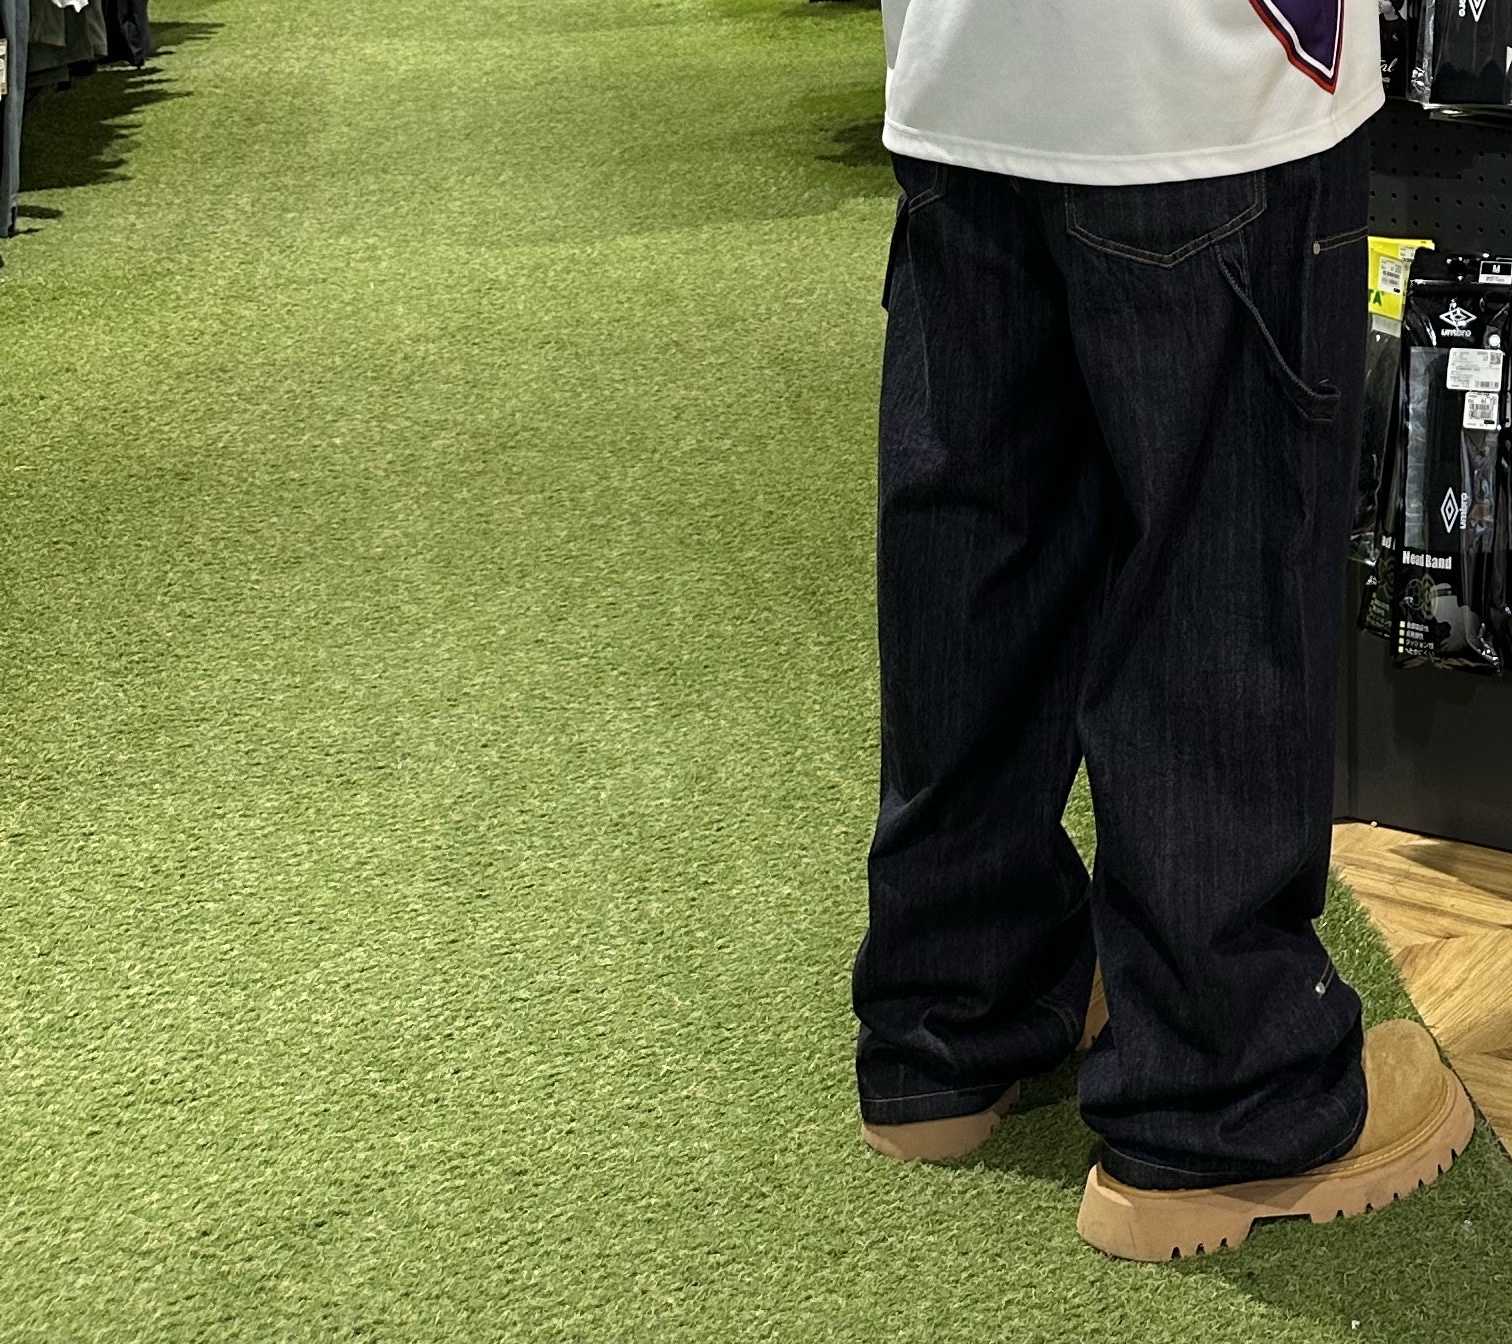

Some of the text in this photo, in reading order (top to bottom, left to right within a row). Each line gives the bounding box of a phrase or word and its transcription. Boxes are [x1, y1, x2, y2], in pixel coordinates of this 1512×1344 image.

[1441, 328, 1471, 337] umbro
[1402, 551, 1452, 569] Head Band
